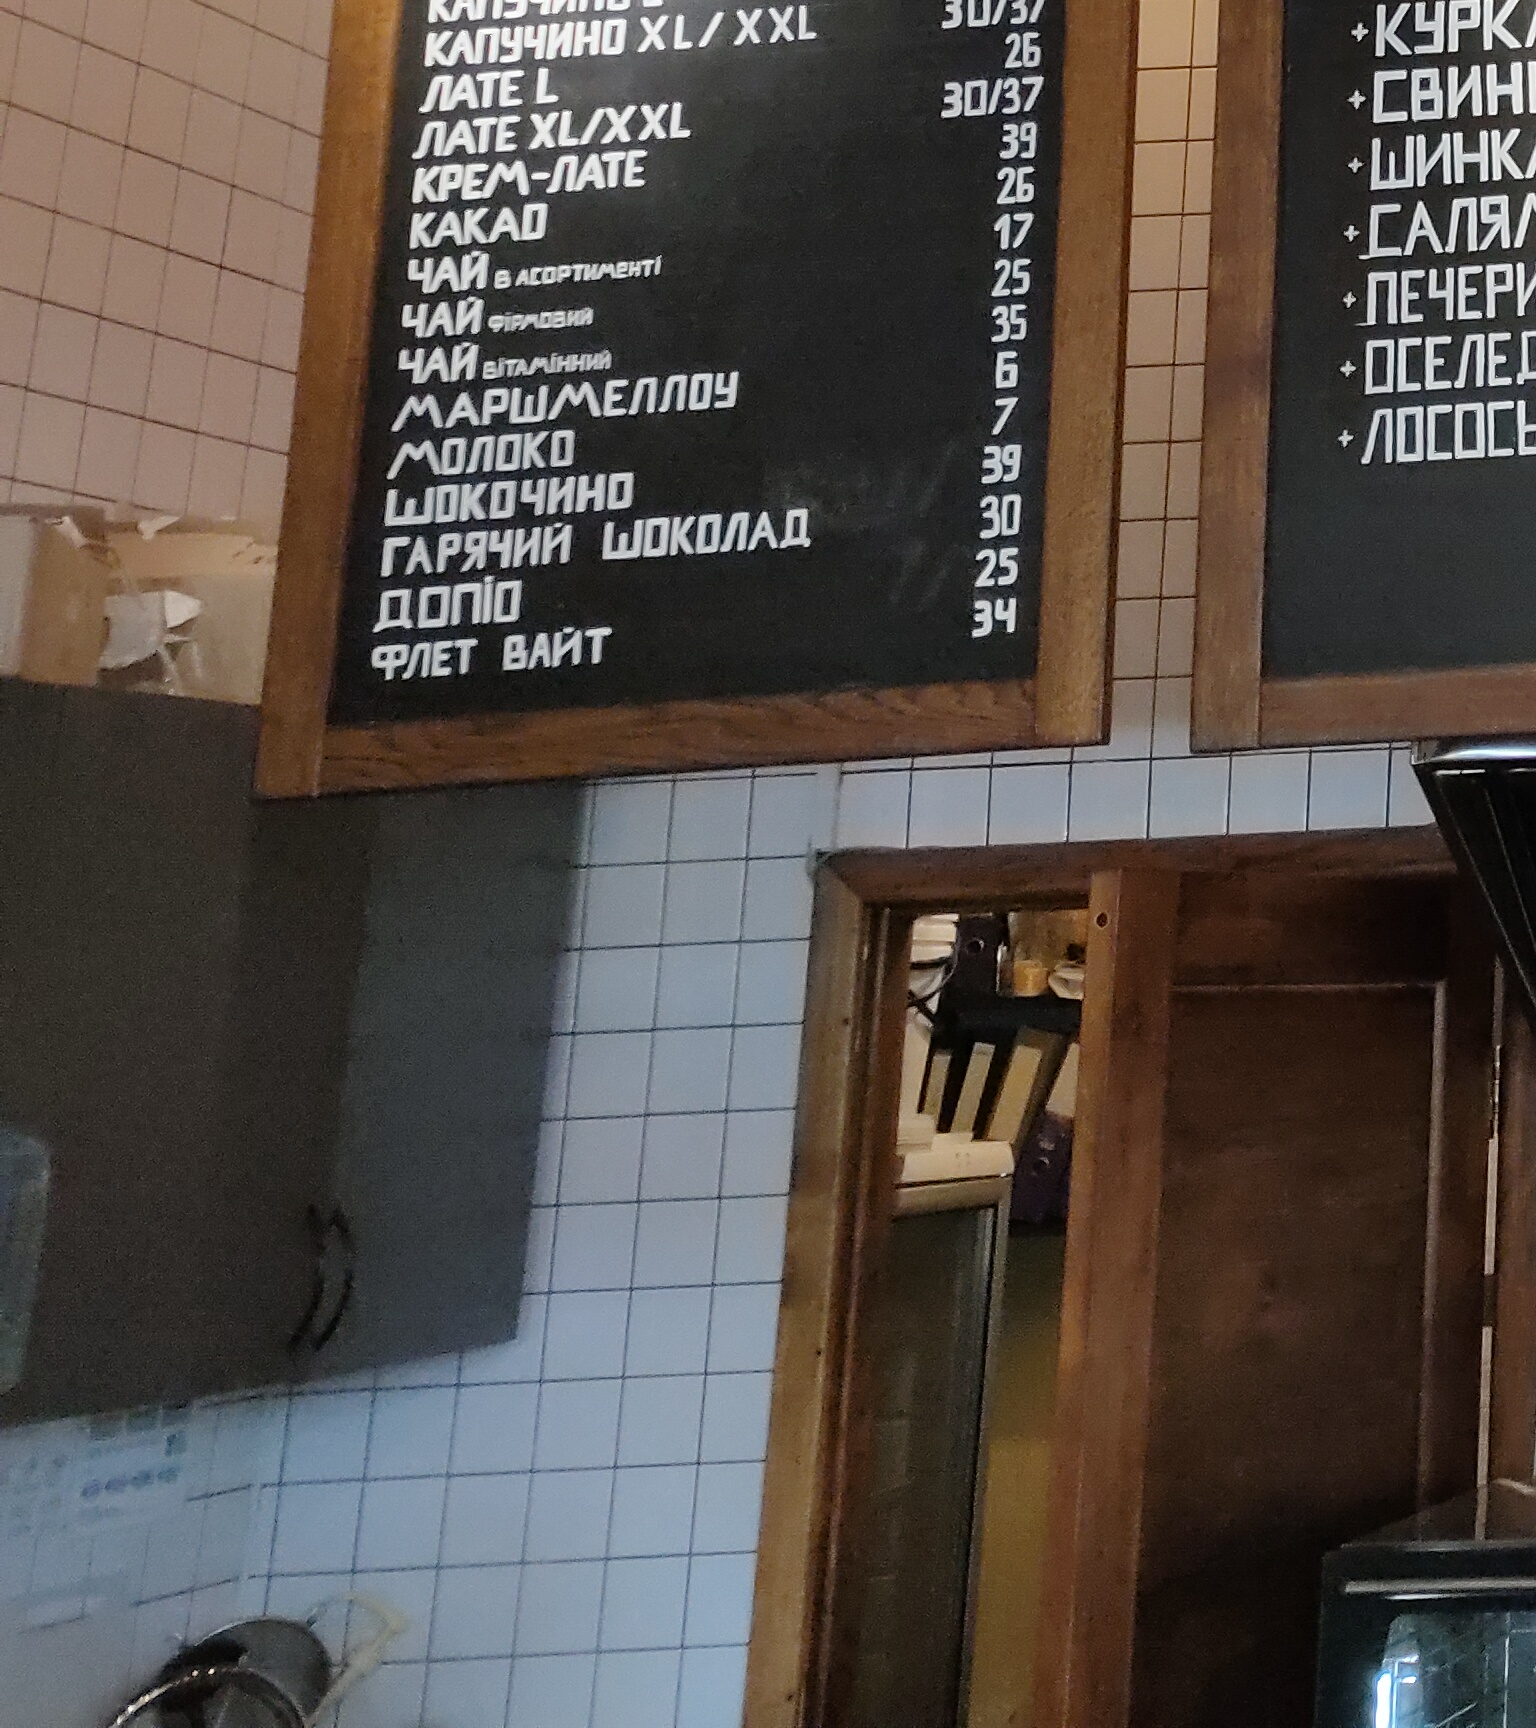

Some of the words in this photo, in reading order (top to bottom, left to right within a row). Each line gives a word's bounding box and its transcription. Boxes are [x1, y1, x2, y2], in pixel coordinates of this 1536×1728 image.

[417, 69, 525, 114] ЛАТЕ
[1004, 31, 1042, 69] 26
[423, 18, 628, 68] КАПУЧИНО
[411, 114, 522, 160] ЛАТЕ
[940, 74, 1045, 119] 30/37
[411, 149, 649, 204] КРЕМ-ЛАТЕ
[998, 121, 1038, 160] 39
[408, 202, 549, 250] КАКАО
[996, 165, 1036, 205] 26
[407, 249, 490, 295] ЧАЙ
[993, 212, 1035, 251] 17
[401, 295, 485, 339] ЧАЙ
[990, 257, 1032, 298] 25
[397, 341, 480, 385] ЧАЙ
[990, 303, 1028, 343] 35
[390, 370, 740, 433] МАРШМЕЛЛОУ
[995, 350, 1019, 389] 6
[386, 429, 576, 480] МОЛОКО
[991, 396, 1020, 436] 7
[383, 471, 635, 527] ШОКОЧИНО
[980, 443, 1023, 485] 39
[380, 522, 573, 578] ГАРЯЧИЙ
[601, 507, 812, 560] ШОКОЛАД
[979, 493, 1023, 540] 30
[371, 574, 523, 634] ДОПІО
[974, 546, 1020, 588] 25
[370, 637, 479, 681] ФЛЕТ
[501, 626, 613, 671] ВАЙТ
[971, 597, 1017, 639] 34
